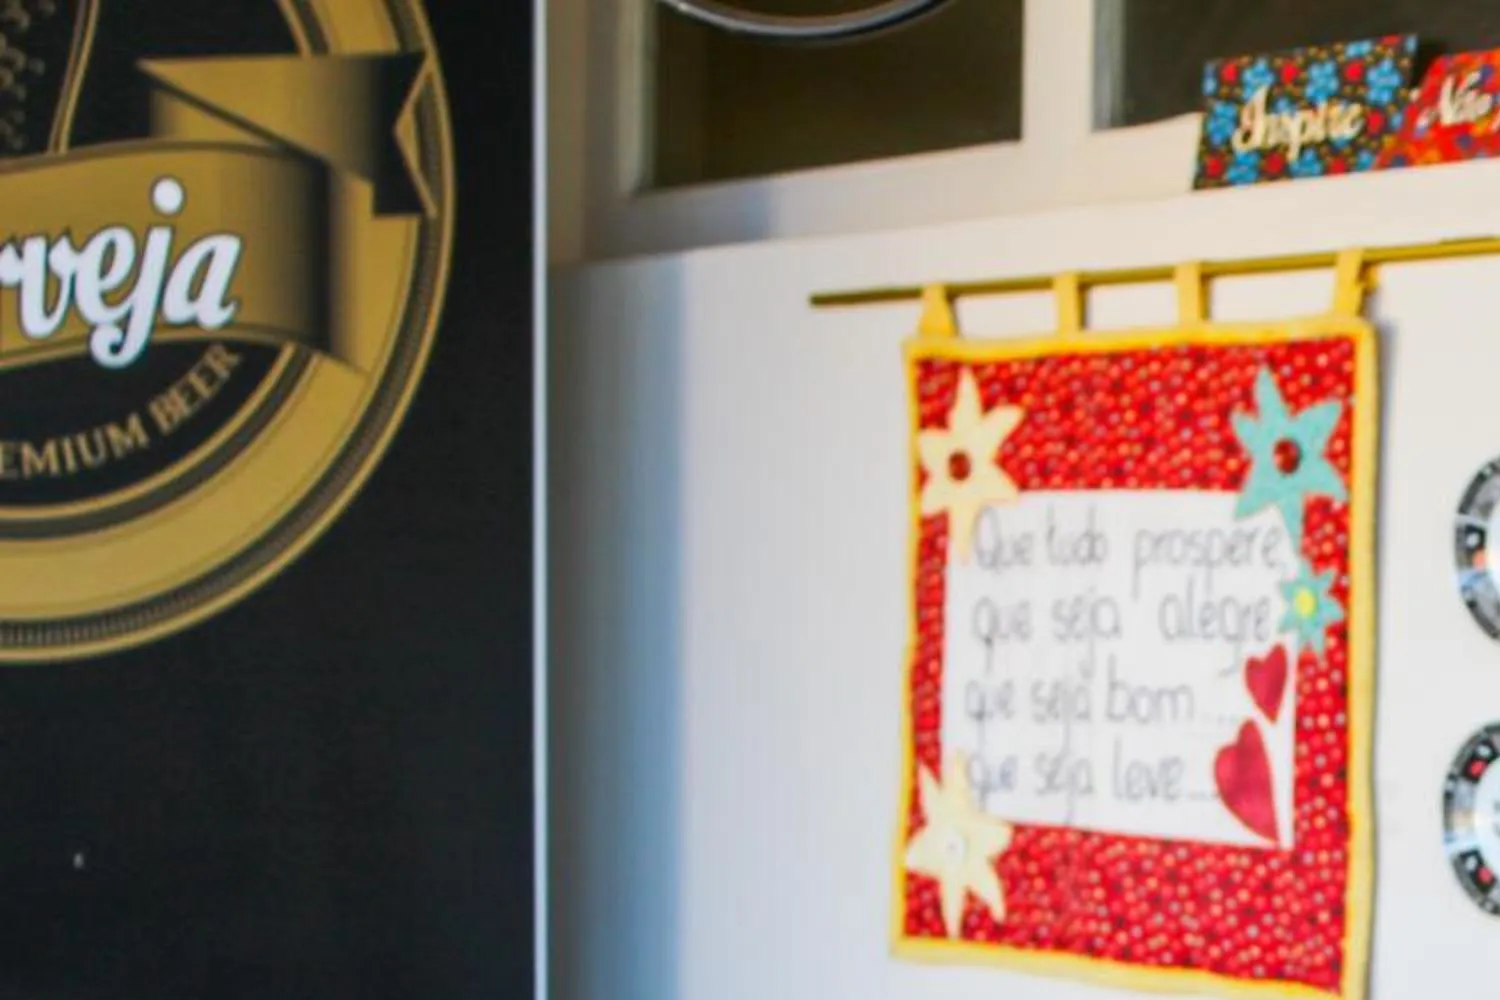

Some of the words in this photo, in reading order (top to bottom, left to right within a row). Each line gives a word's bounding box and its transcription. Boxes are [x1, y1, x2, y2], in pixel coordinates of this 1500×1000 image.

[1232, 86, 1365, 161] Inspire
[149, 343, 241, 436] BEER
[972, 504, 1034, 574] Que
[1046, 504, 1110, 567] tudo
[971, 595, 1034, 676] que
[1050, 583, 1123, 679] seja
[1157, 573, 1272, 679] alegre
[964, 679, 1015, 745] que
[966, 752, 1019, 813] que
[1034, 750, 1096, 824] seja
